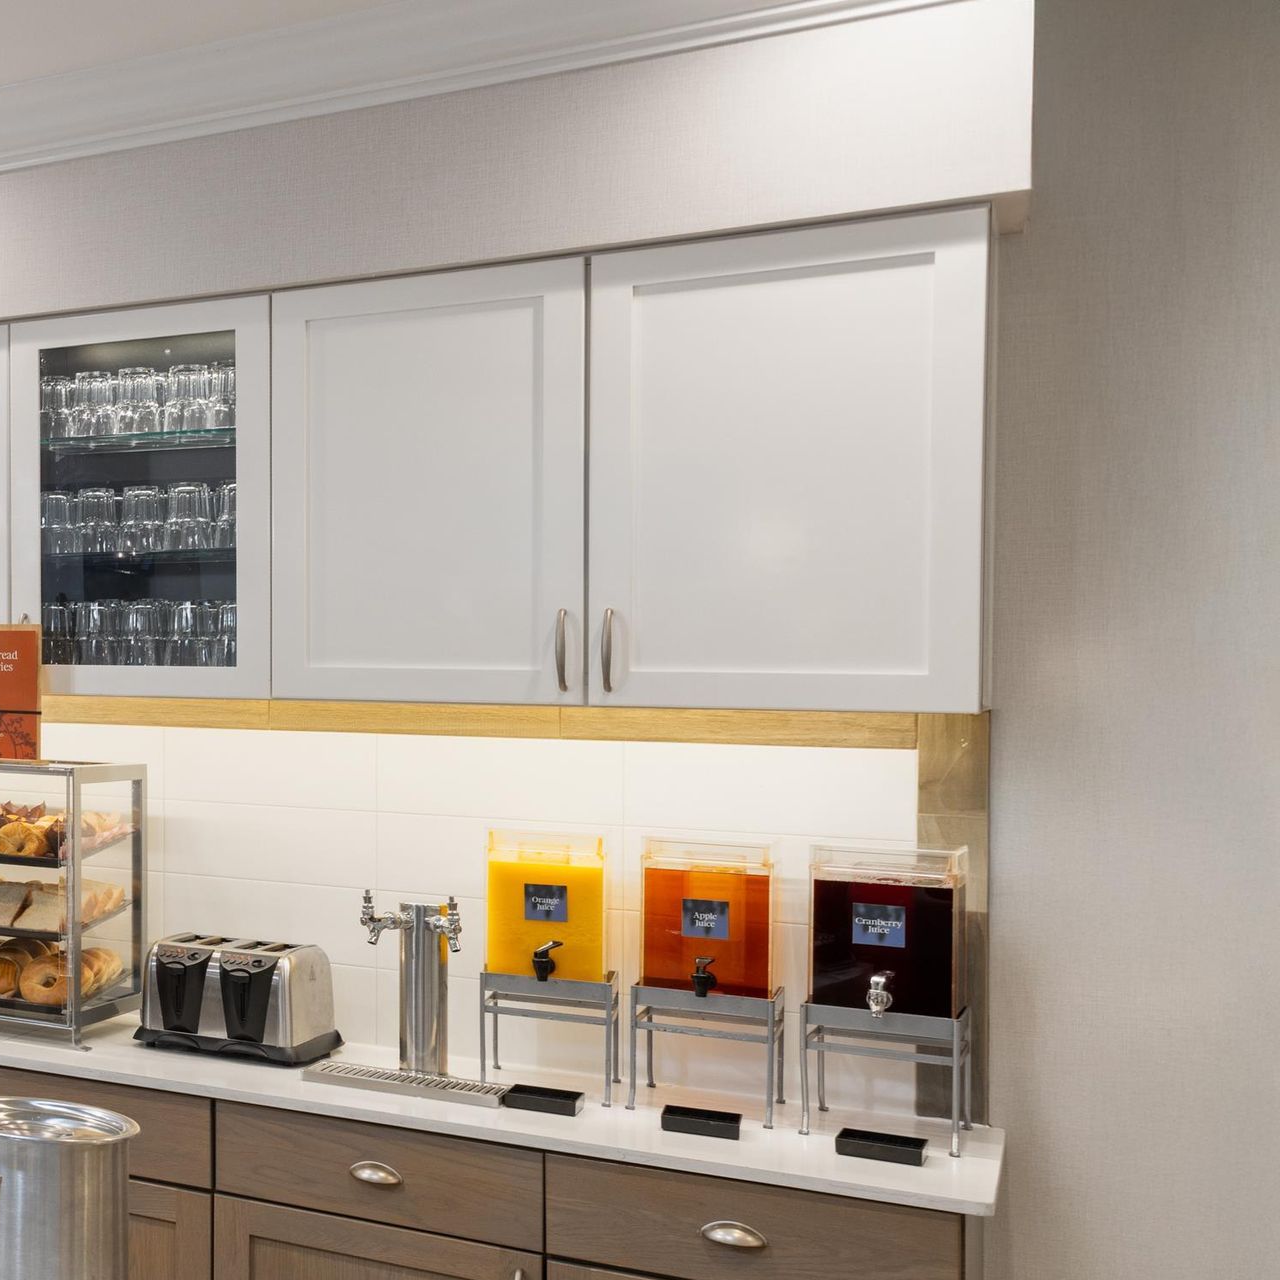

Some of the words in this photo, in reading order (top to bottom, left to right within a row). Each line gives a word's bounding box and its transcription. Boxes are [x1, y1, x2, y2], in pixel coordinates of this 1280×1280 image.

[532, 896, 560, 906] Orange
[693, 912, 717, 922] Apple
[695, 919, 716, 928] Juice
[855, 917, 903, 929] Cranberry
[869, 926, 890, 934] Juice
